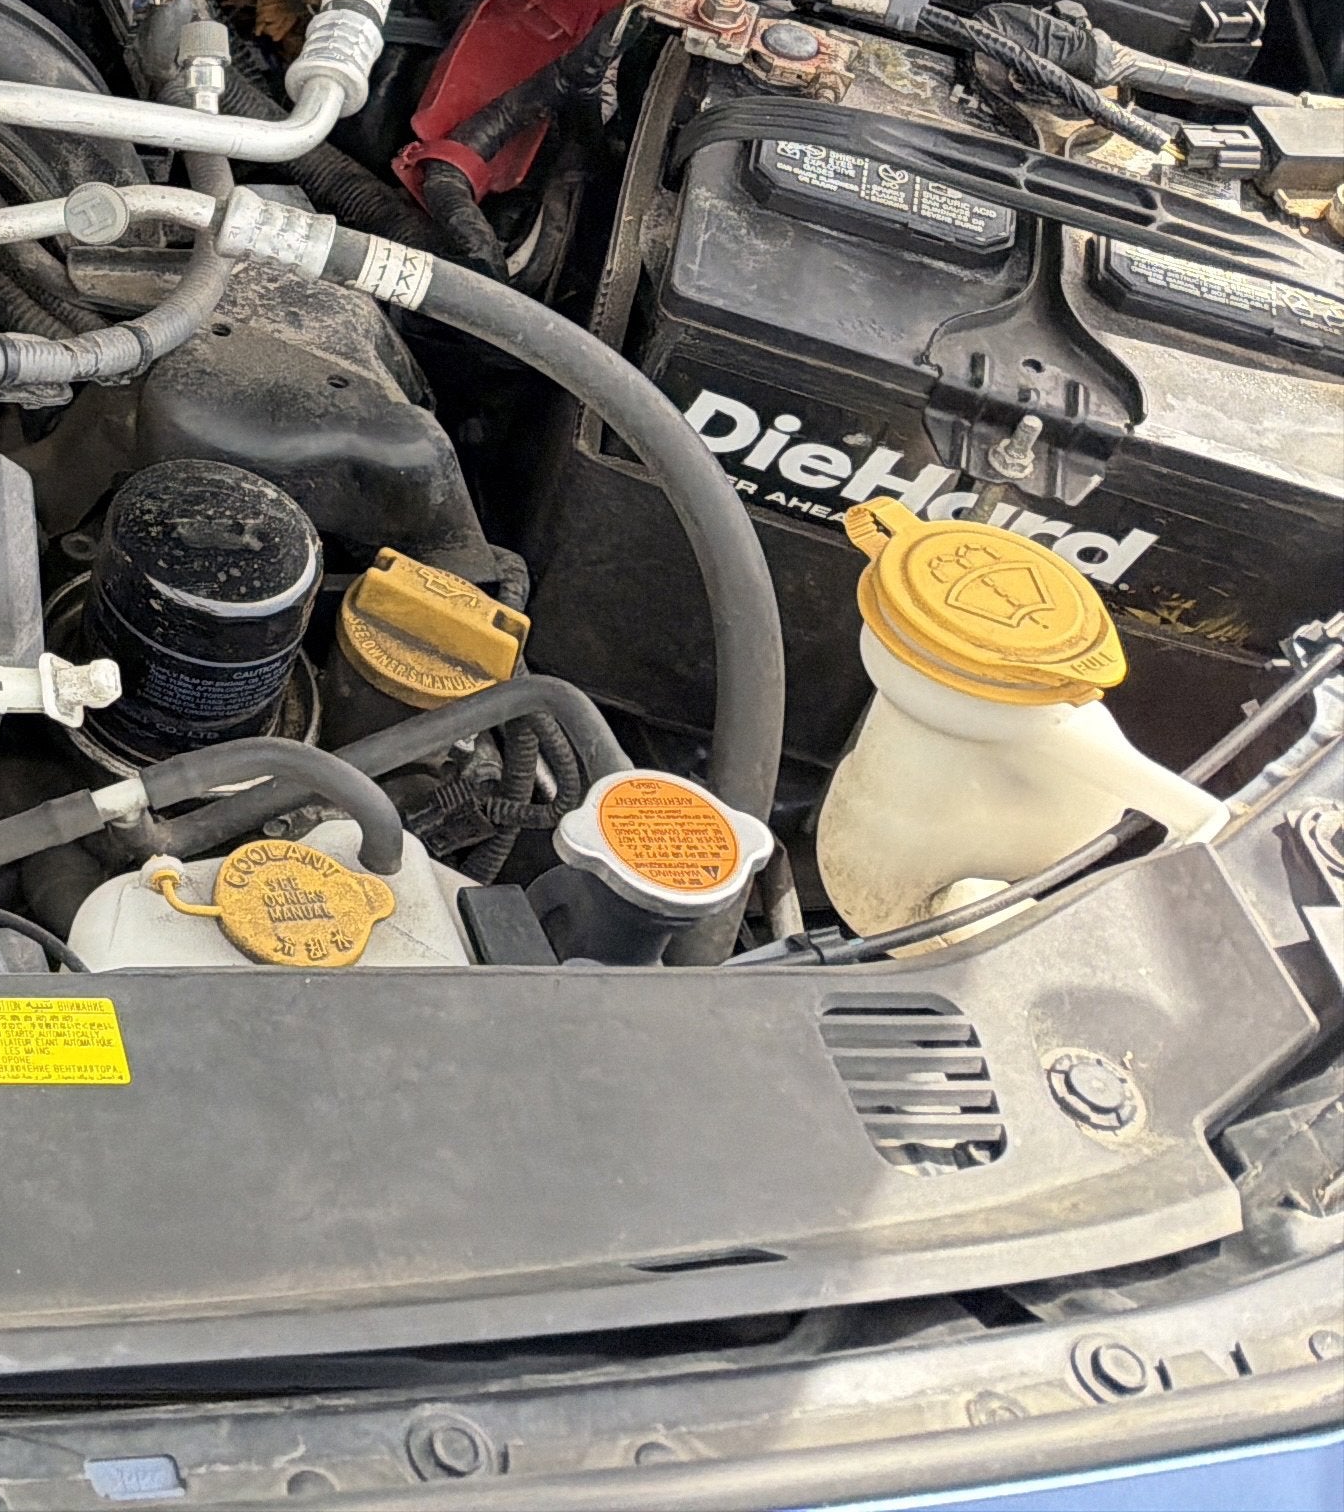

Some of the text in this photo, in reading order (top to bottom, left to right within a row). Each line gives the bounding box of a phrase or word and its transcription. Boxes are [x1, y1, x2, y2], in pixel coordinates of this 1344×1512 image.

[923, 191, 997, 219] SULFURIC ACID
[765, 491, 845, 523] AHEA
[348, 615, 370, 639] SEE
[422, 673, 483, 691] MANUAL
[232, 660, 283, 680] CAUTION
[614, 797, 693, 807] AVERTISSEMENT
[224, 843, 341, 888] COOLANT
[265, 877, 300, 892] SEE
[268, 904, 336, 923] MANUAL
[5, 1047, 21, 1055] LES
